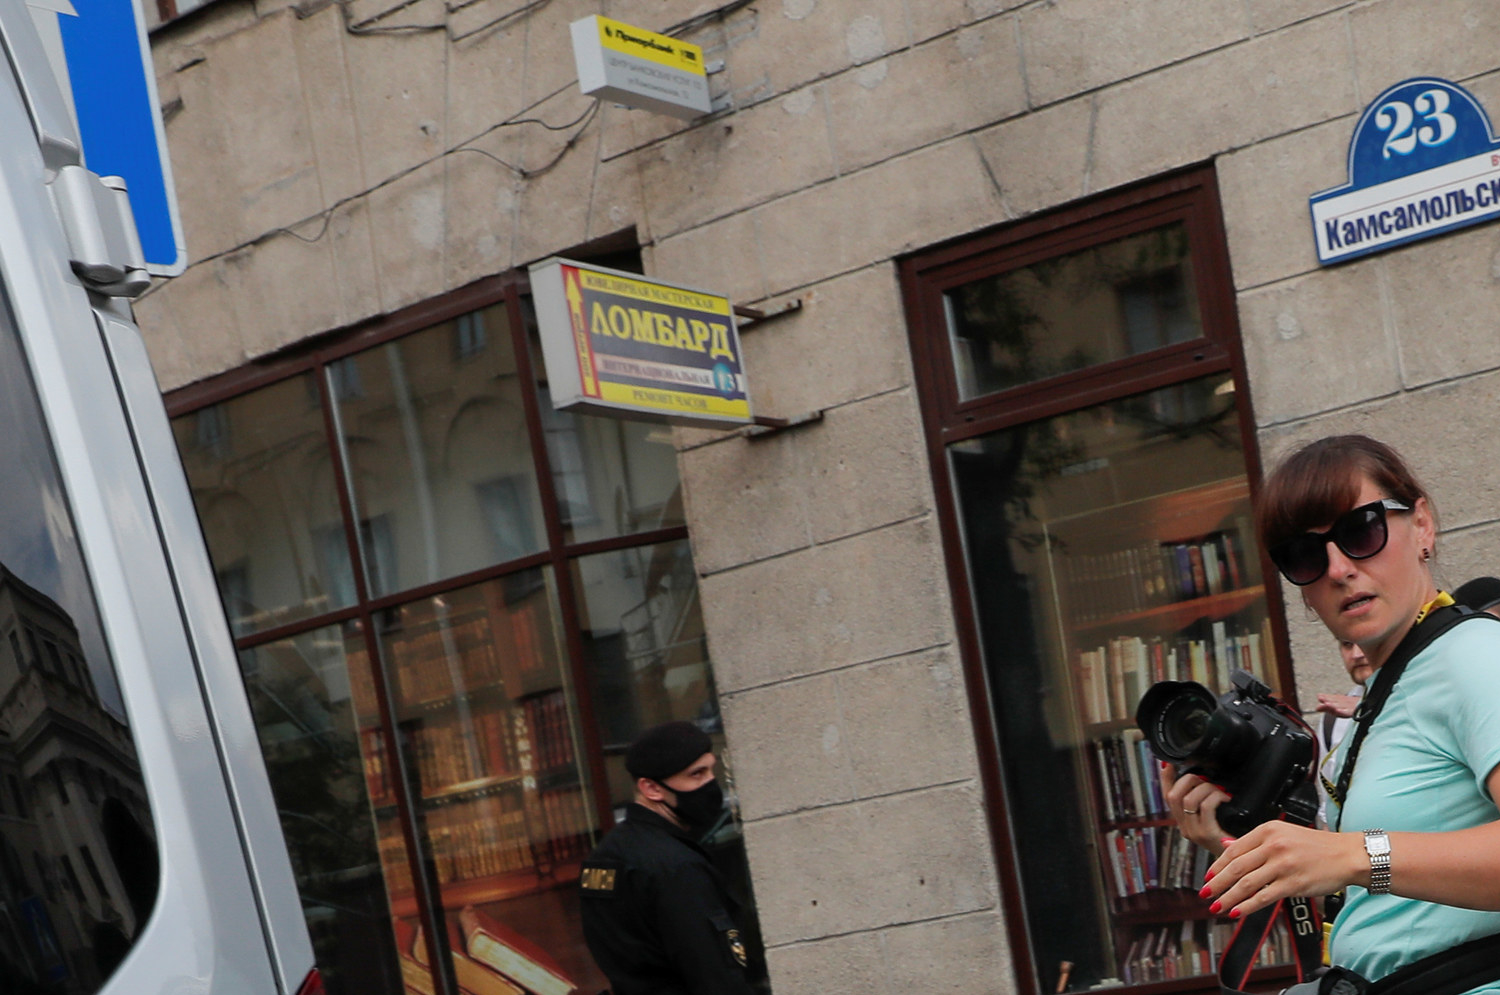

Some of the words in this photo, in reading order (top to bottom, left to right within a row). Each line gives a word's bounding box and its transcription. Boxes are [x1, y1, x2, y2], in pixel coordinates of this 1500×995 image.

[1375, 89, 1458, 160] 23
[651, 286, 714, 309] МАСТЕРСКАЯ
[591, 301, 736, 363] ЛОМБАРД
[632, 389, 673, 405] РЕМОНТ
[676, 395, 708, 409] ЧАСОВ
